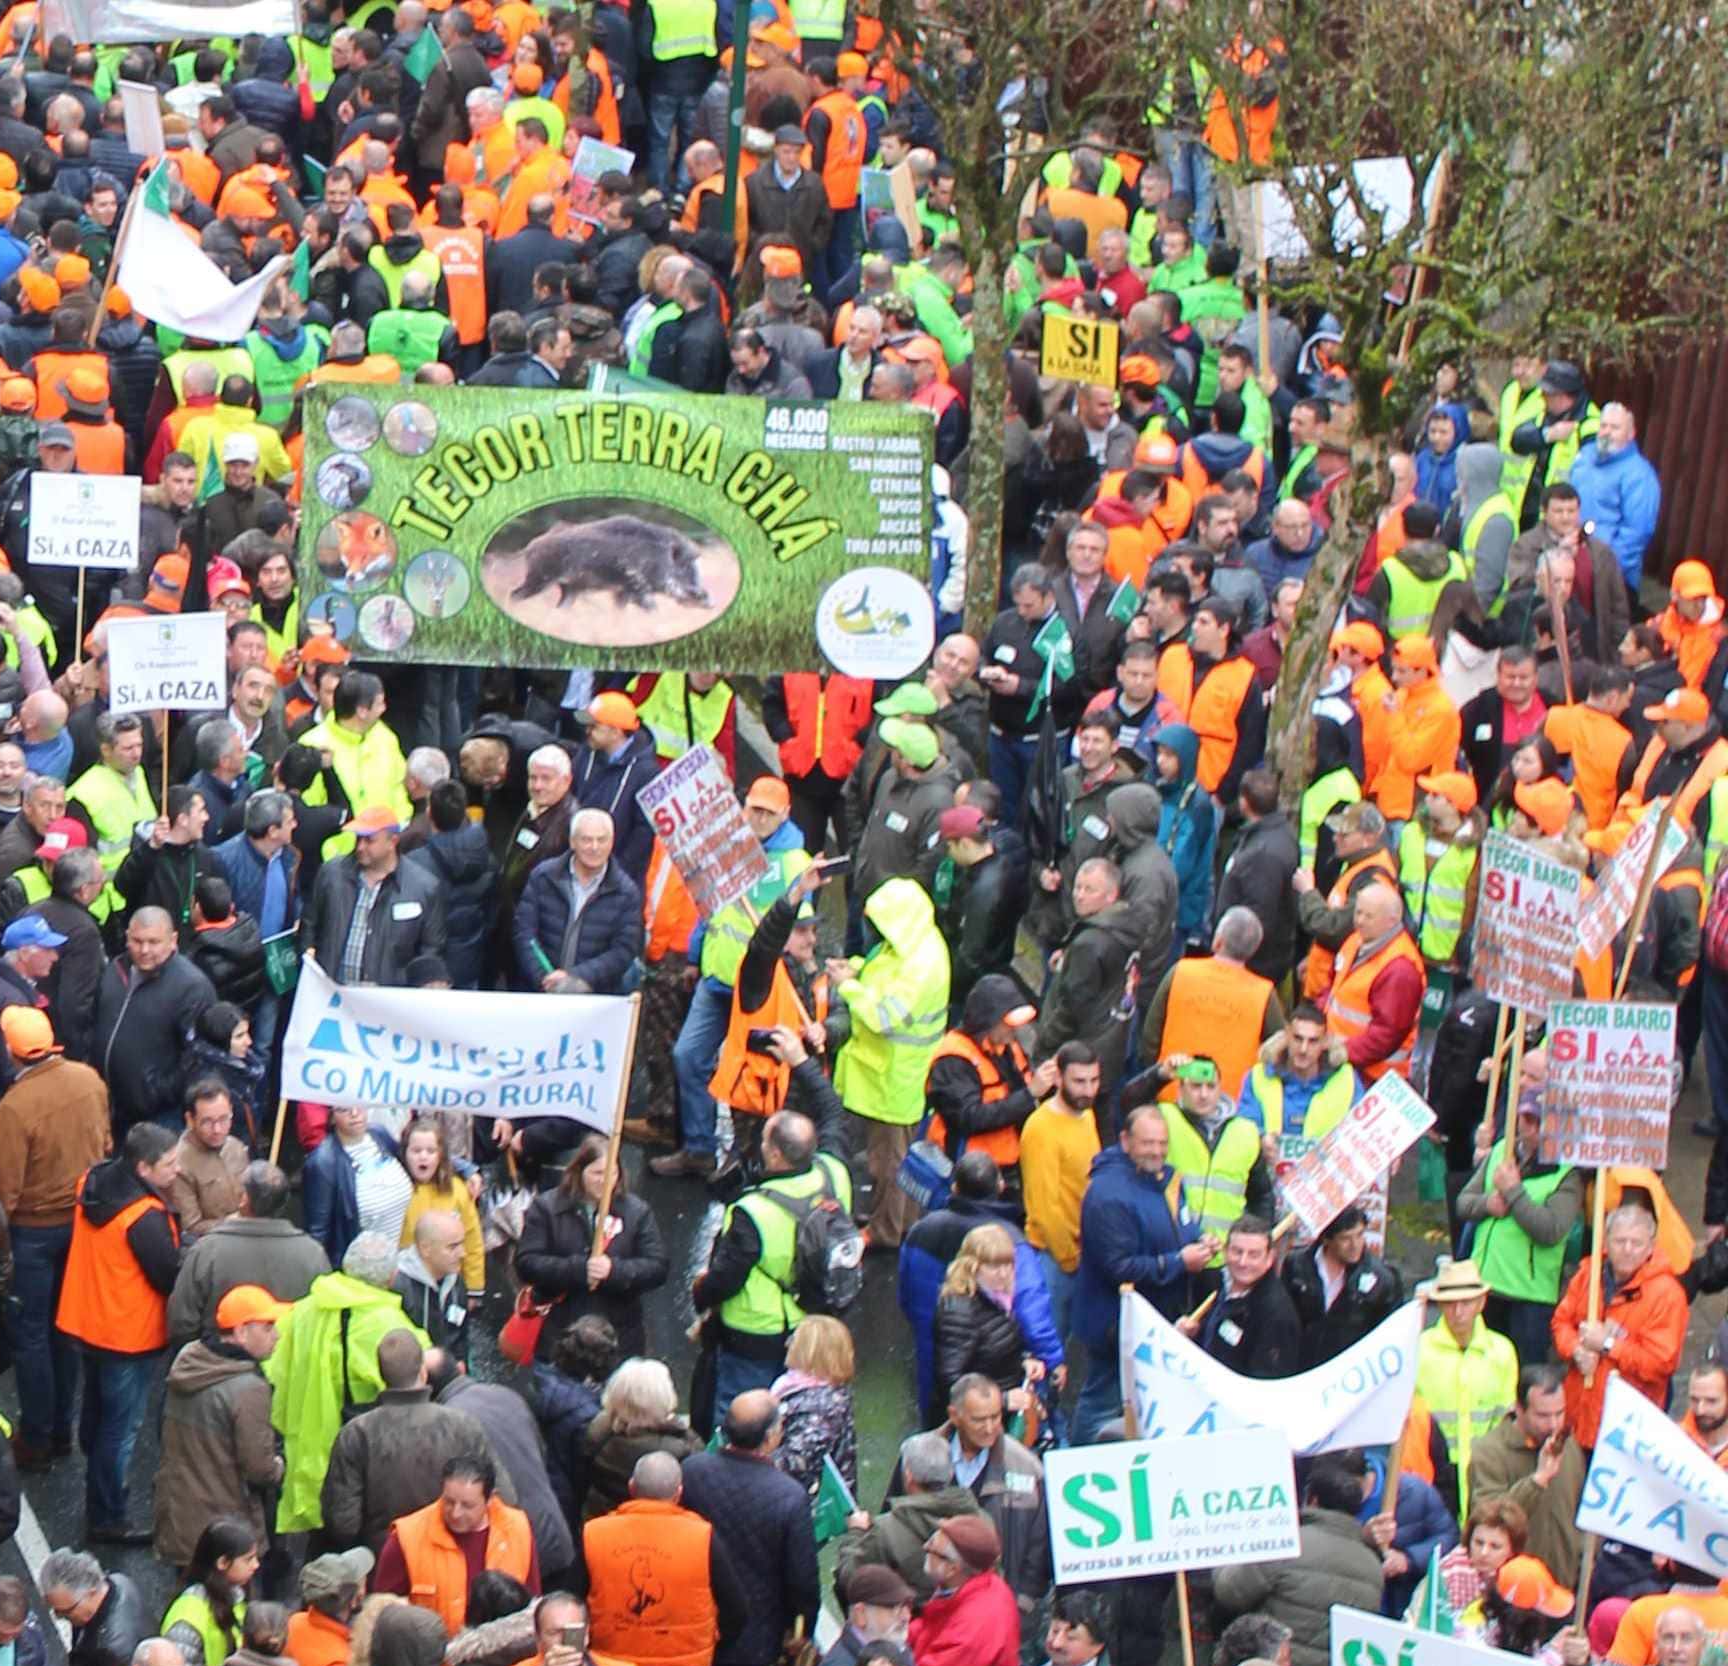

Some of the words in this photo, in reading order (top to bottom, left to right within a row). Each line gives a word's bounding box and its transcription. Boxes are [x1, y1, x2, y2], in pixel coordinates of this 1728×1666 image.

[1067, 323, 1100, 360] SI
[765, 407, 829, 433] 46.000
[848, 457, 871, 472] SAN
[389, 412, 553, 542] TECOR
[555, 401, 726, 486] TERRA
[723, 449, 843, 564] CHÁ
[76, 538, 133, 559] CAZA
[159, 680, 219, 701] CAZA
[1485, 870, 1521, 908] SI
[1551, 1003, 1608, 1027] TECOR
[1613, 1005, 1672, 1031] BARRO
[1552, 1029, 1598, 1063] SI
[1629, 1033, 1644, 1050] A
[1604, 1050, 1667, 1069] CAZA
[357, 1067, 487, 1108] MUNDO
[499, 1080, 598, 1112] RURAL
[1062, 1452, 1153, 1548] SÍ
[1170, 1489, 1190, 1520] Á
[1202, 1484, 1288, 1516] CAZA
[1060, 1555, 1123, 1574] SOCIEDAD
[1127, 1553, 1144, 1567] DE
[1147, 1549, 1181, 1563] CAZA
[1184, 1548, 1192, 1560] Y
[1196, 1544, 1235, 1559] PESCA
[1239, 1538, 1295, 1555] CASELAS
